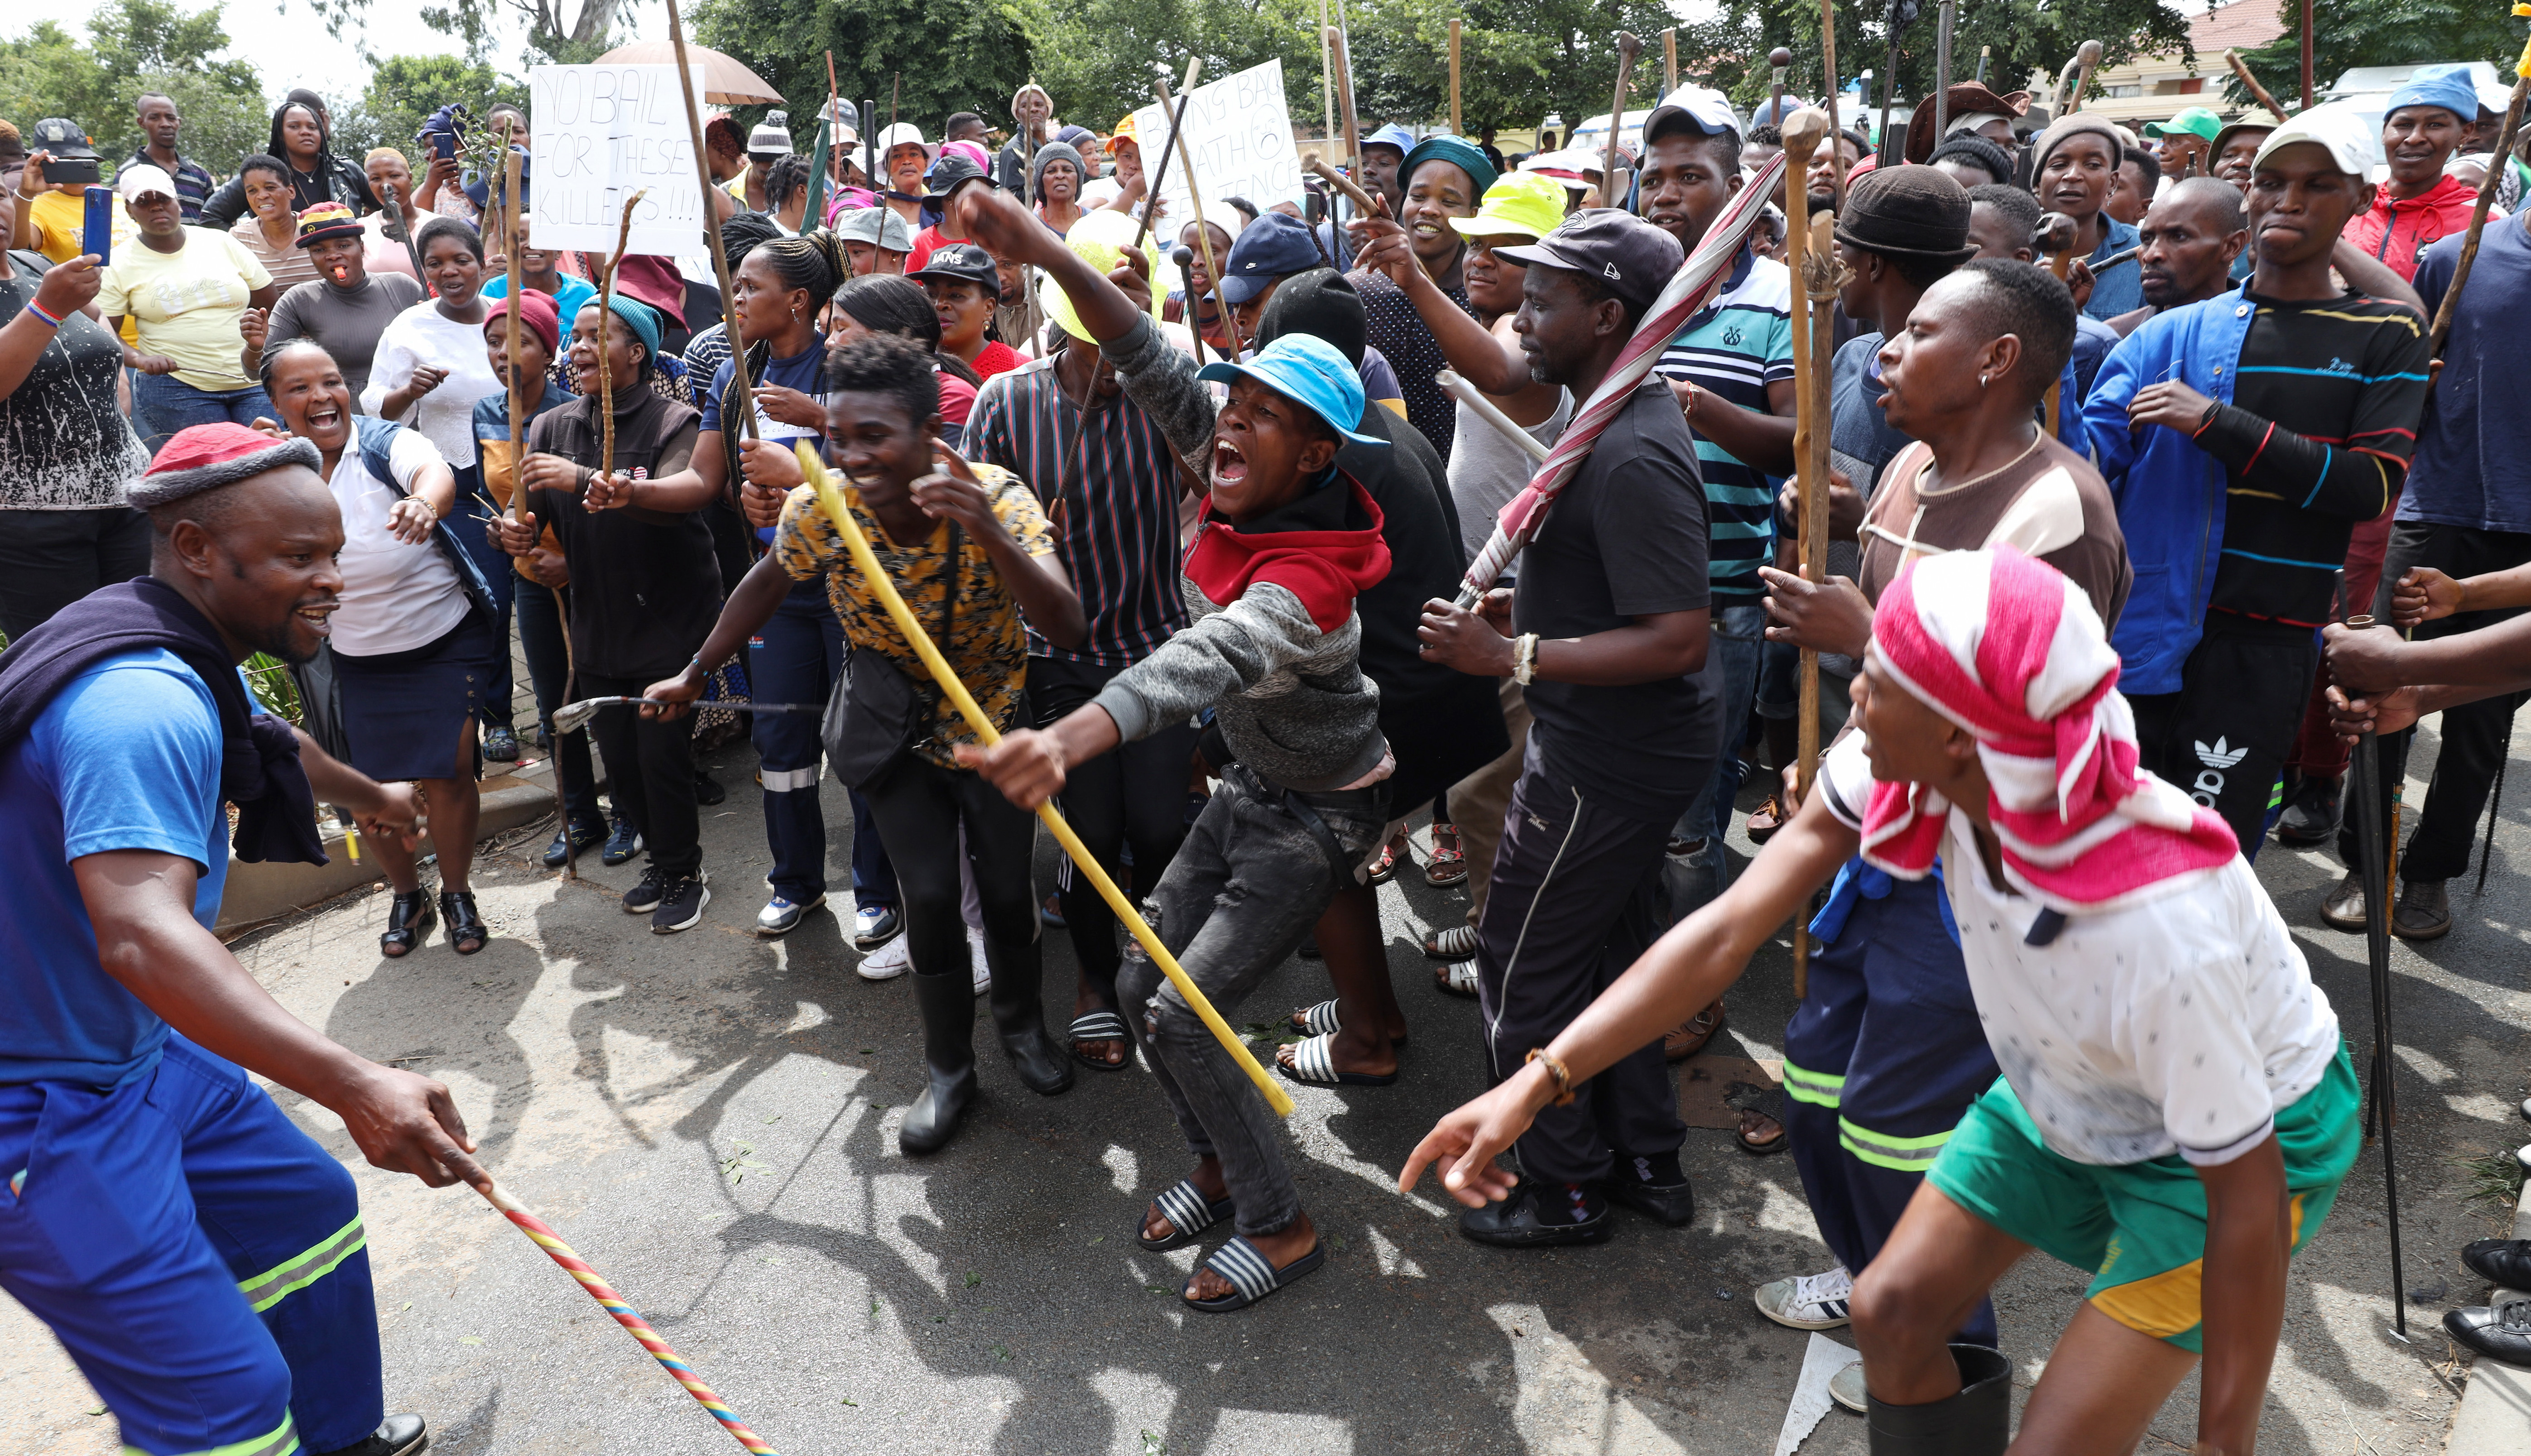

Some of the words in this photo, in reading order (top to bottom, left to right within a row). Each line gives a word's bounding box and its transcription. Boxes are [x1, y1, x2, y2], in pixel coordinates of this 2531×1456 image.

[537, 70, 581, 125] NO
[590, 69, 666, 125] BAIL
[1237, 67, 1284, 110] BACK
[536, 132, 594, 178] FOR
[607, 135, 693, 175] THESE
[1152, 130, 1246, 194] DEATH
[932, 251, 964, 265] VANS
